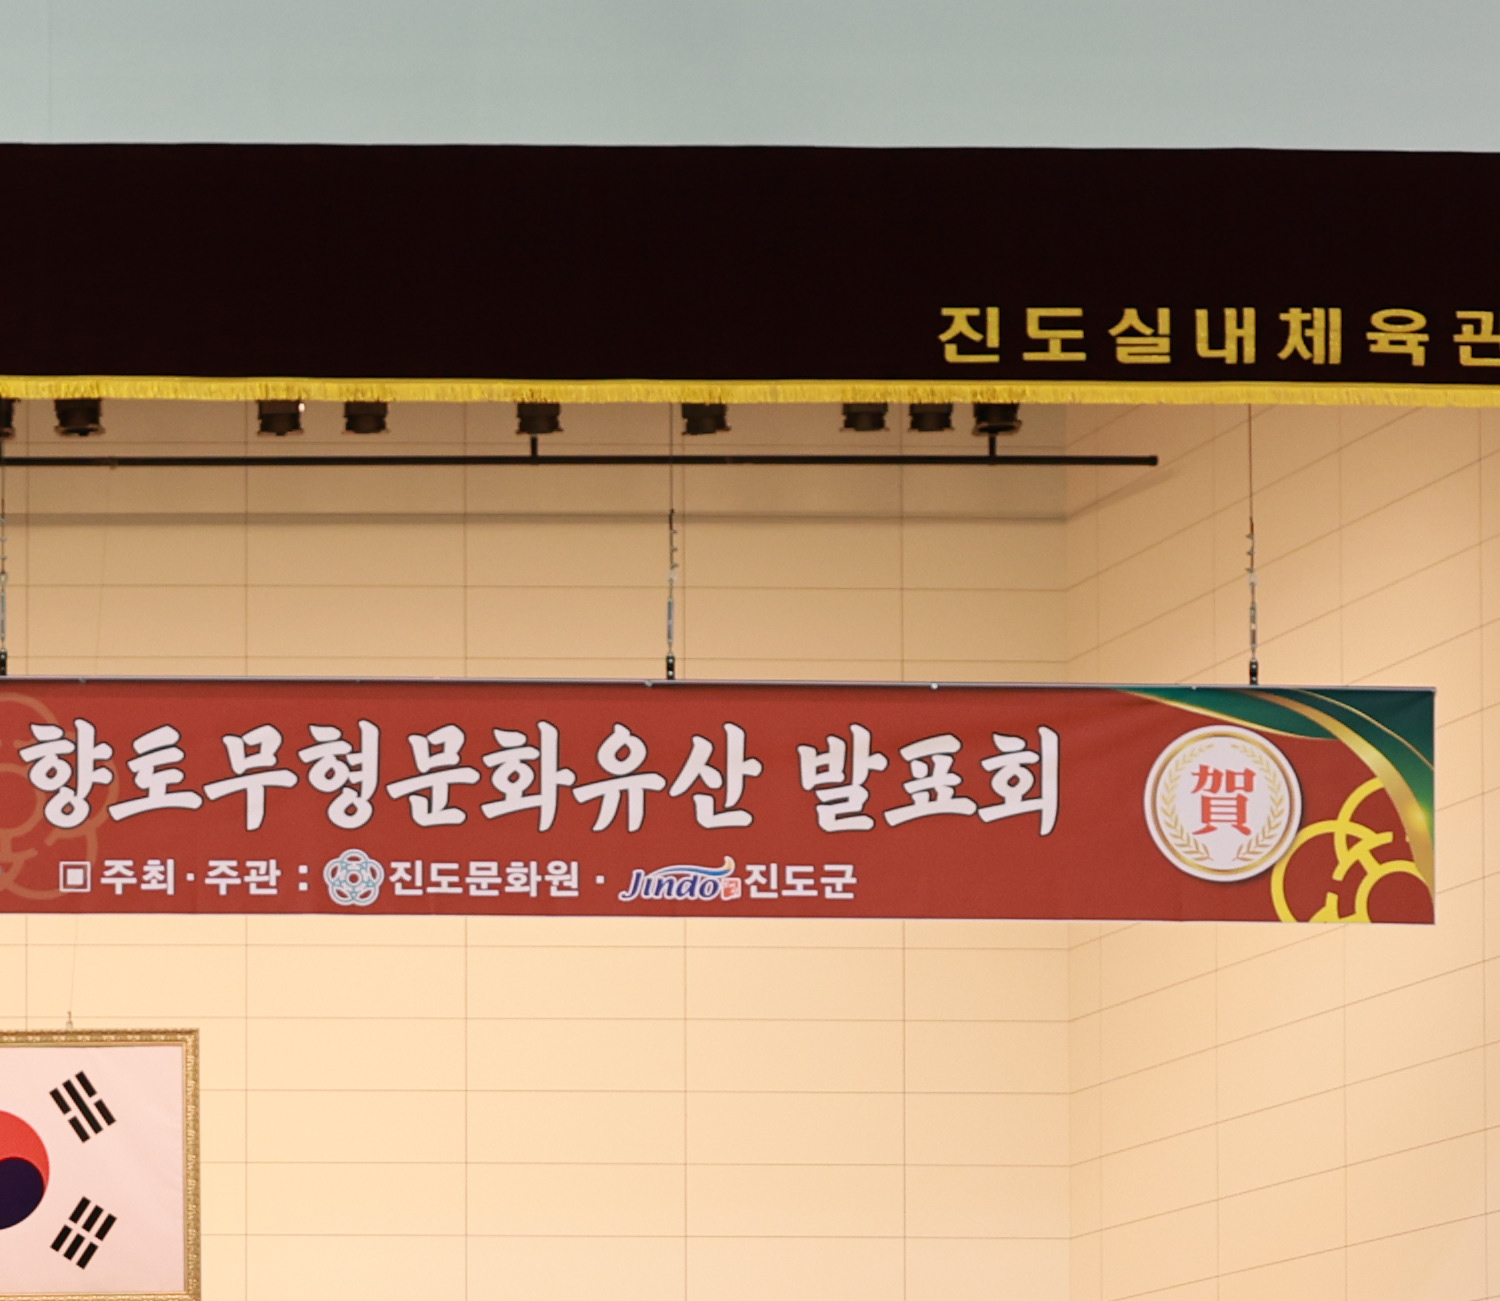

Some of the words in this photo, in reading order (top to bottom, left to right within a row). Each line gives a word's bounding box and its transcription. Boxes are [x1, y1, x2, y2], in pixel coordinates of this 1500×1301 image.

[18, 718, 764, 834] 향토무형문화유산
[797, 724, 1061, 838] 발표회
[1190, 765, 1257, 838] 賀
[390, 861, 580, 898] 진도문화원
[745, 864, 858, 900] 진도군
